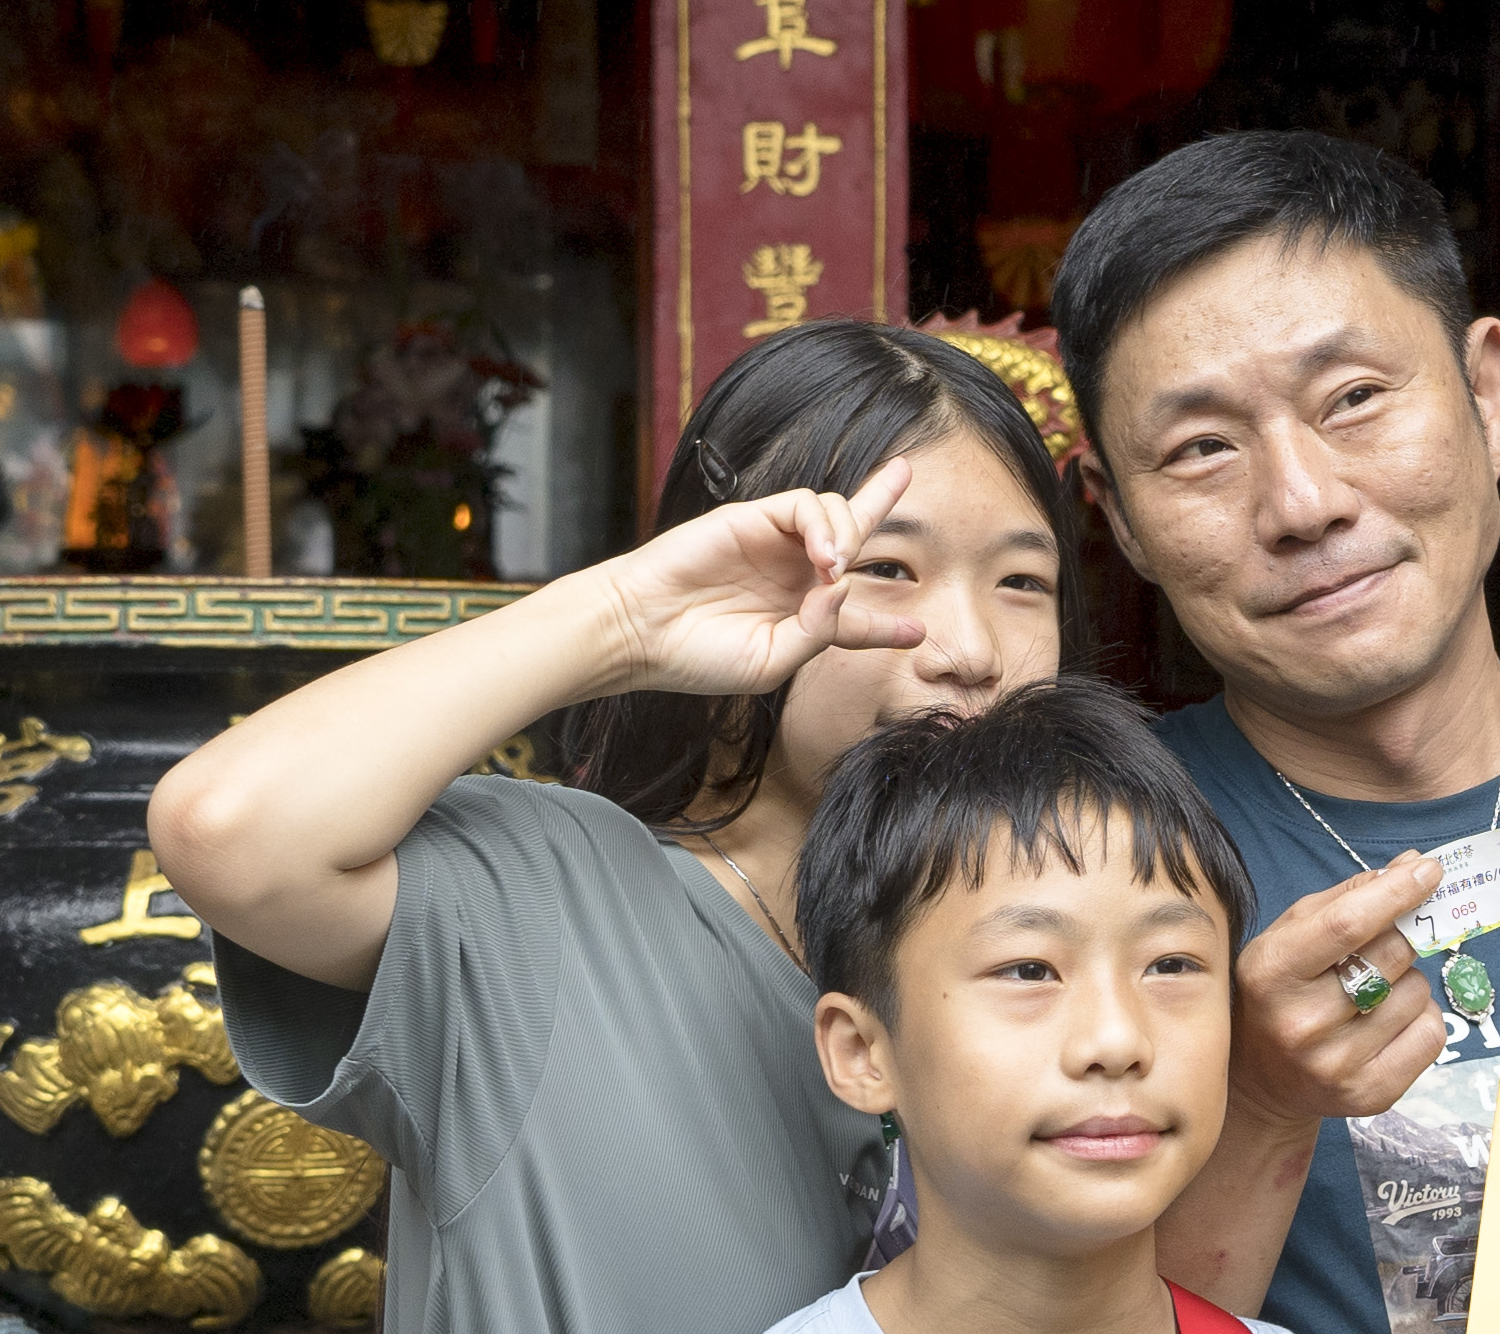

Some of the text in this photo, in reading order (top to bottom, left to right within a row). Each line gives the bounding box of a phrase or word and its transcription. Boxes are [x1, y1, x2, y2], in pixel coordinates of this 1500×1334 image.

[1450, 900, 1478, 921] 069
[1377, 1178, 1463, 1213] Victory
[1431, 1205, 1463, 1222] 1993
